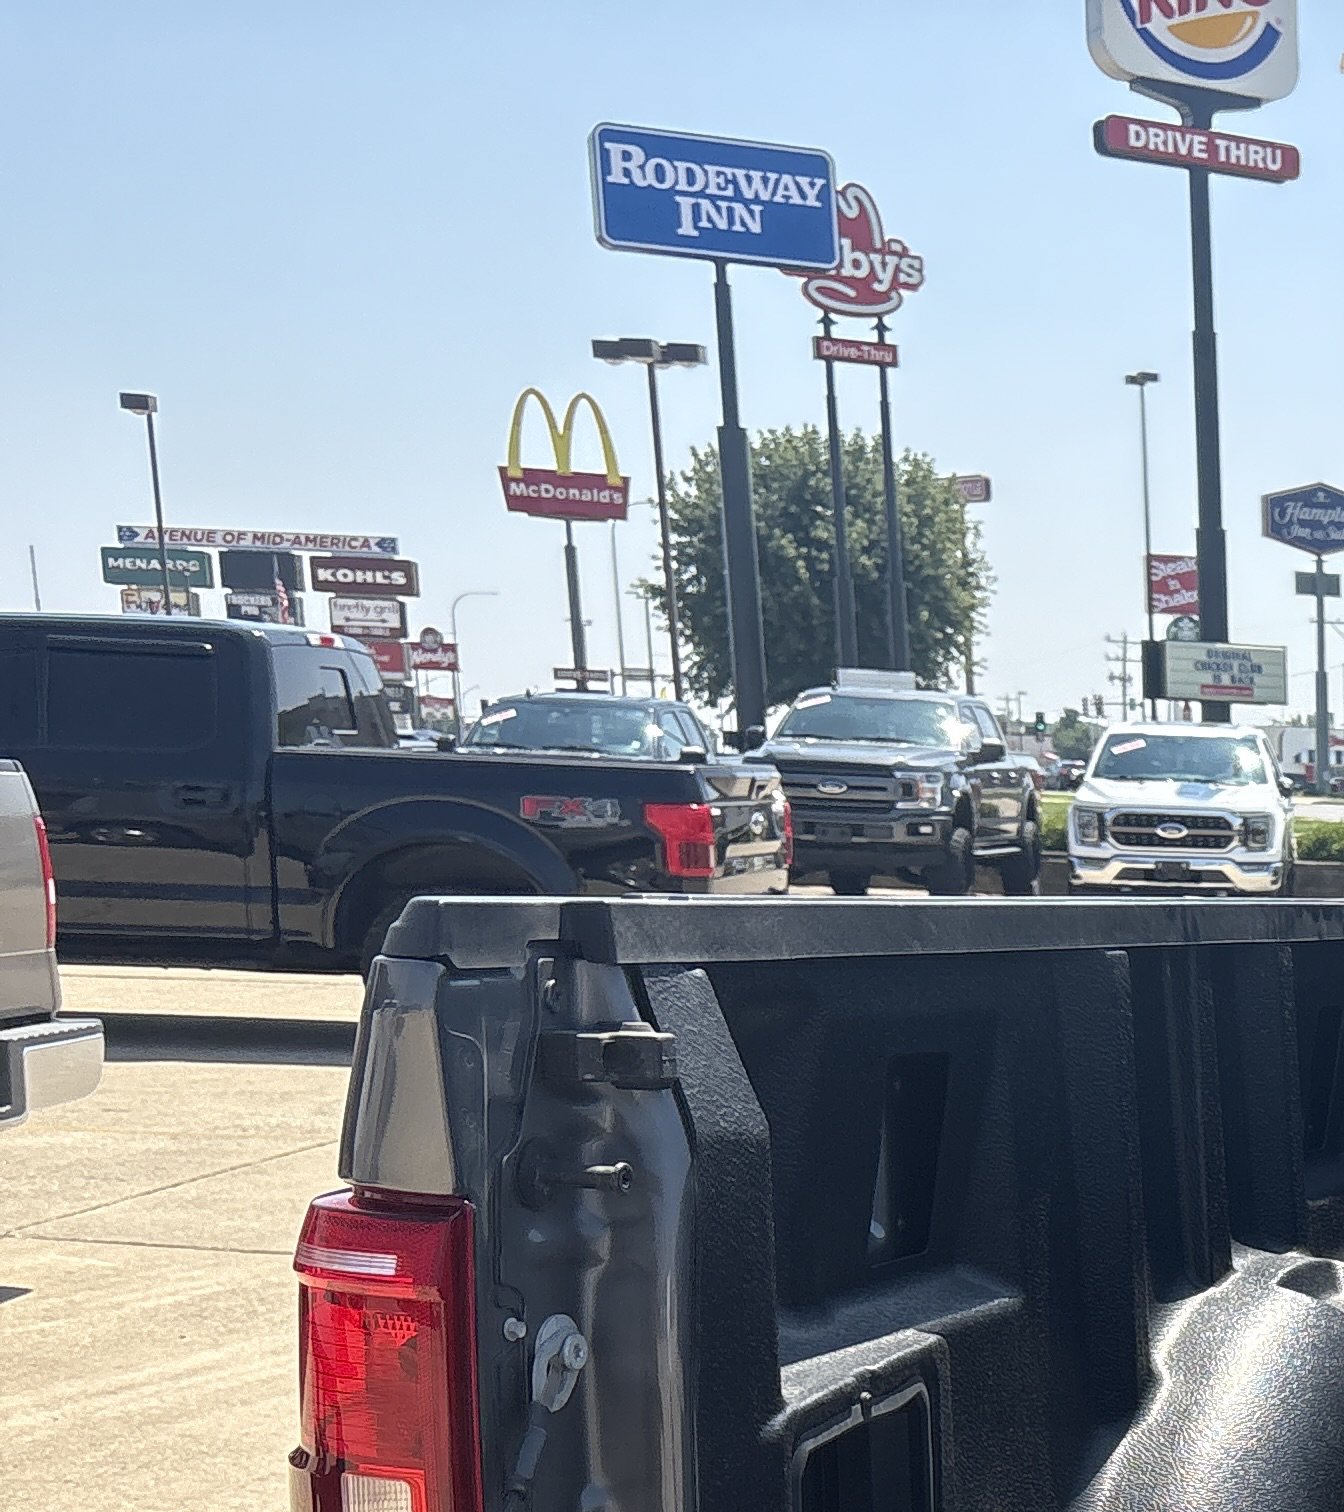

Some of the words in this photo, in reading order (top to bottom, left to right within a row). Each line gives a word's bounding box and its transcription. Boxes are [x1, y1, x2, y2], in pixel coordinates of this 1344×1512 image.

[1138, 0, 1272, 26] KI
[1127, 123, 1209, 159] DRIVE
[1214, 138, 1283, 171] THRU
[603, 141, 827, 208] RODEWAY
[674, 194, 764, 238] INN
[838, 237, 924, 292] by's
[822, 339, 894, 362] Drive-Thru
[508, 480, 624, 506] McDonald's
[222, 531, 248, 544] OF
[251, 533, 373, 551] MID-AMERICA
[1282, 524, 1312, 540] Inn
[317, 567, 407, 585] KOHL'S
[519, 795, 622, 823] FX4
